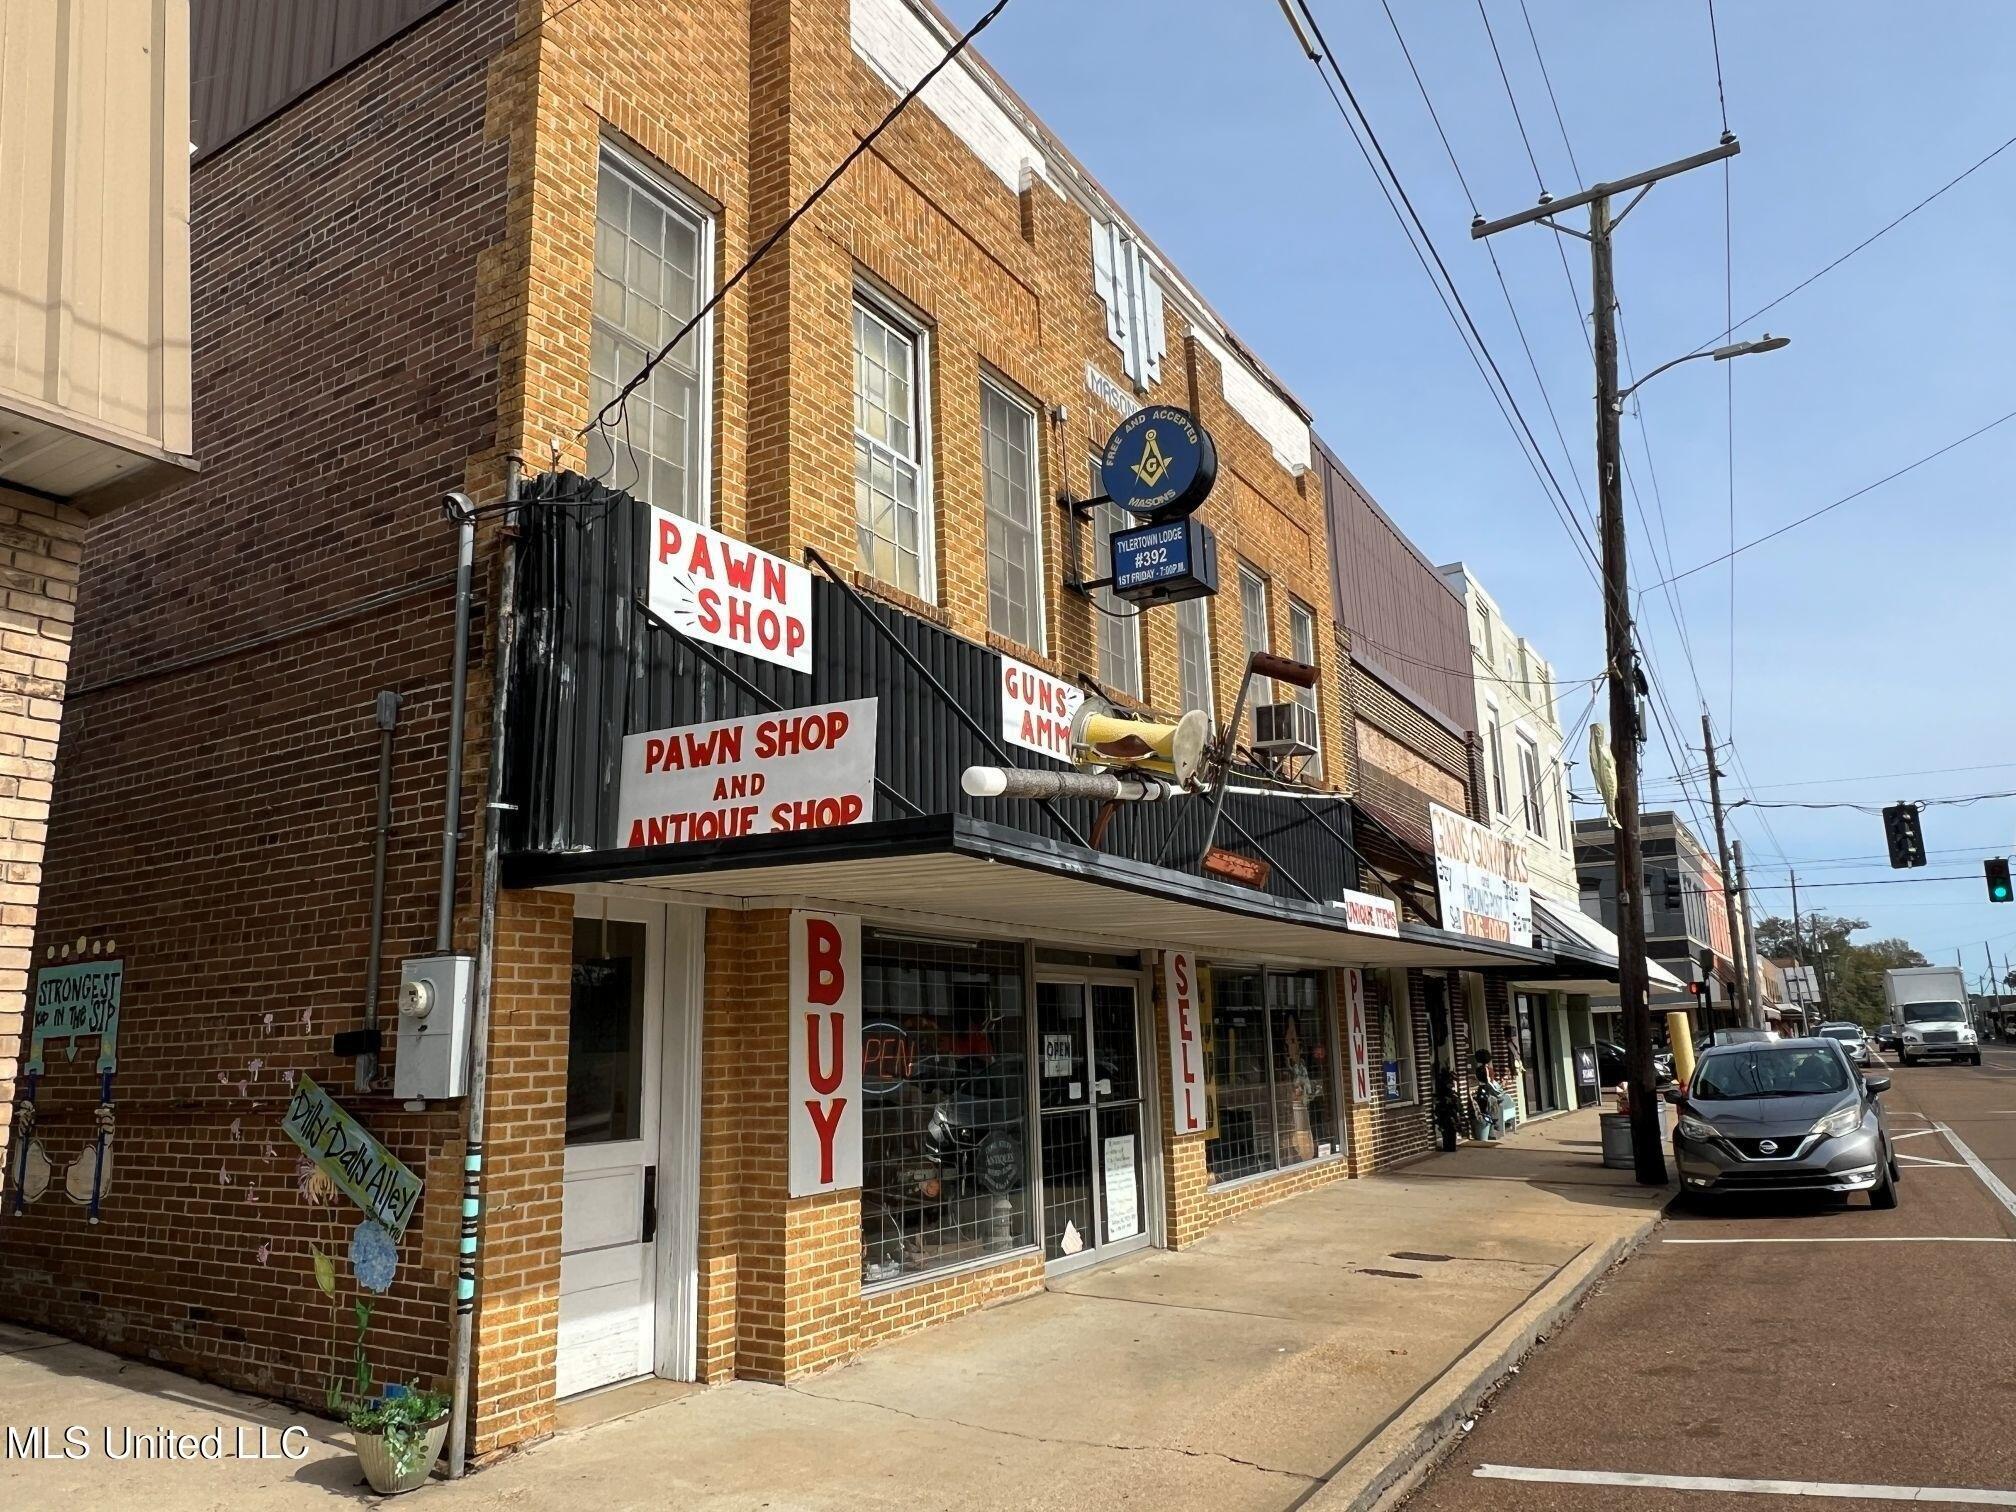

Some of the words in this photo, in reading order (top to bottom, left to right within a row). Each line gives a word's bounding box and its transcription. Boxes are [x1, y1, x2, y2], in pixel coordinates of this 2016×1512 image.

[1091, 369, 1138, 419] MASON
[1106, 435, 1122, 466] FREE
[1125, 414, 1146, 434] AND
[1152, 410, 1198, 445] ACCEPTED
[1146, 458, 1158, 473] G
[1128, 489, 1176, 508] MASONS
[659, 518, 787, 605] PAWN
[1117, 533, 1158, 553] TYLERTOWN
[1159, 527, 1183, 544] LODGE
[1135, 548, 1168, 568] #392
[1118, 574, 1130, 586] 1ST
[1131, 569, 1155, 583] FRIDAY
[697, 588, 805, 658] SHOP
[1005, 667, 1067, 718] GUNS
[645, 726, 744, 774] PAWN
[754, 711, 849, 759] SHOP
[1021, 710, 1072, 757] AMM
[712, 773, 766, 801] AND
[627, 805, 759, 849] ANTIQUE
[770, 794, 863, 834] SHOP
[1346, 901, 1376, 927] UNIQUE
[1376, 908, 1397, 931] ITEMS
[38, 972, 121, 1006] STRONGEST
[54, 1006, 65, 1026] IN
[1350, 969, 1367, 1099] PAWN
[805, 918, 847, 1184] BUY
[863, 1039, 915, 1077] PEN
[1047, 1041, 1070, 1060] OPEN
[1174, 954, 1198, 1130] SELL
[291, 1089, 330, 1149] Dilly
[324, 1121, 373, 1186] Dally
[366, 1162, 416, 1222] Alley
